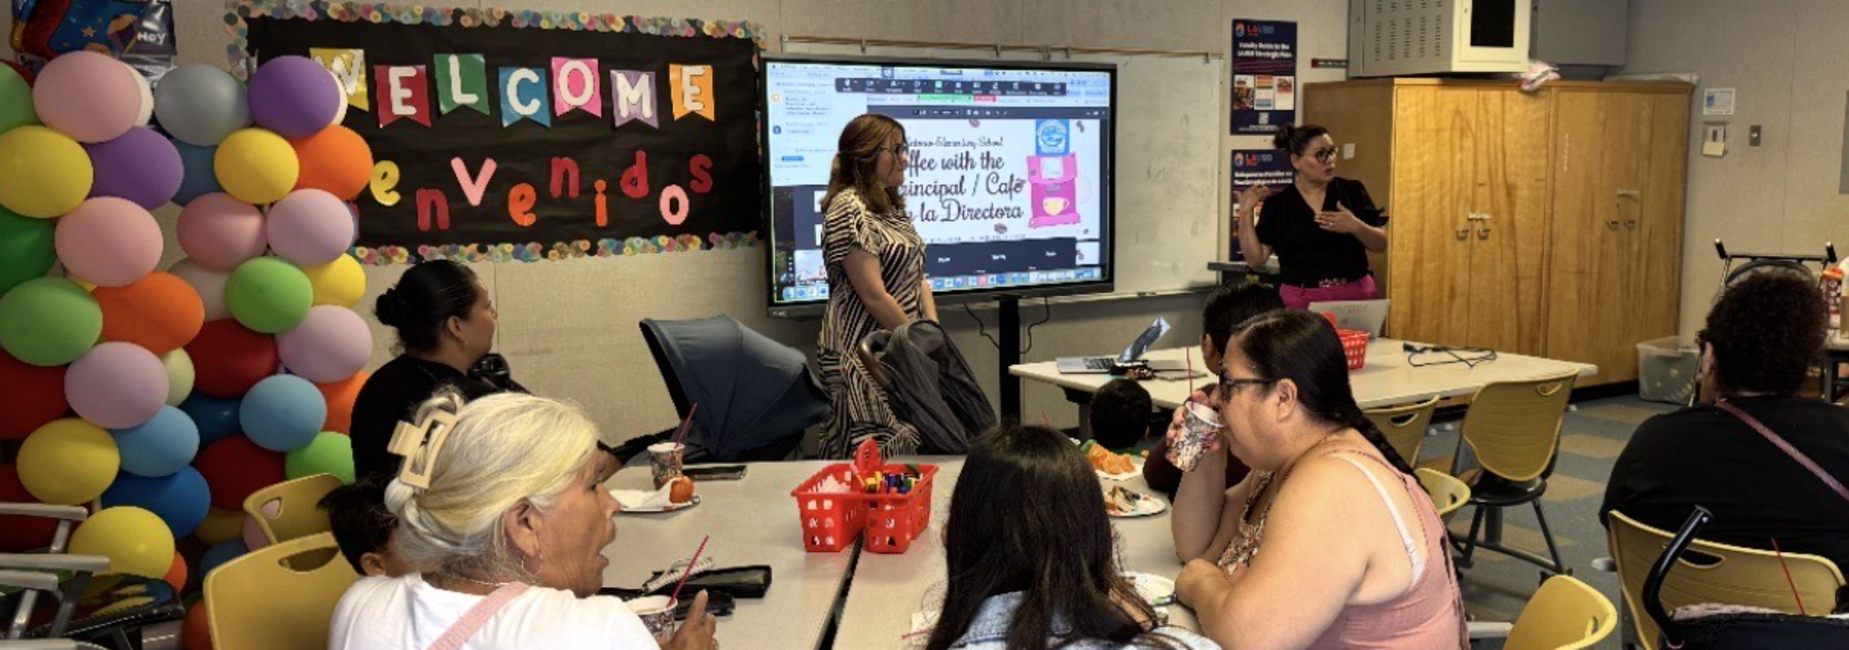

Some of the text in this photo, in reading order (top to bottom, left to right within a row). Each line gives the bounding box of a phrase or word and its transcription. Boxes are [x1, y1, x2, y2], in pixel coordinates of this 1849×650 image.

[137, 31, 166, 45] Hoy
[314, 49, 705, 118] WELCOME
[903, 149, 1005, 177] offee with the
[350, 149, 713, 231] envenidos
[899, 174, 967, 203] rincipal
[971, 173, 980, 197] /
[920, 201, 938, 222] la
[940, 198, 1024, 222] Directora
